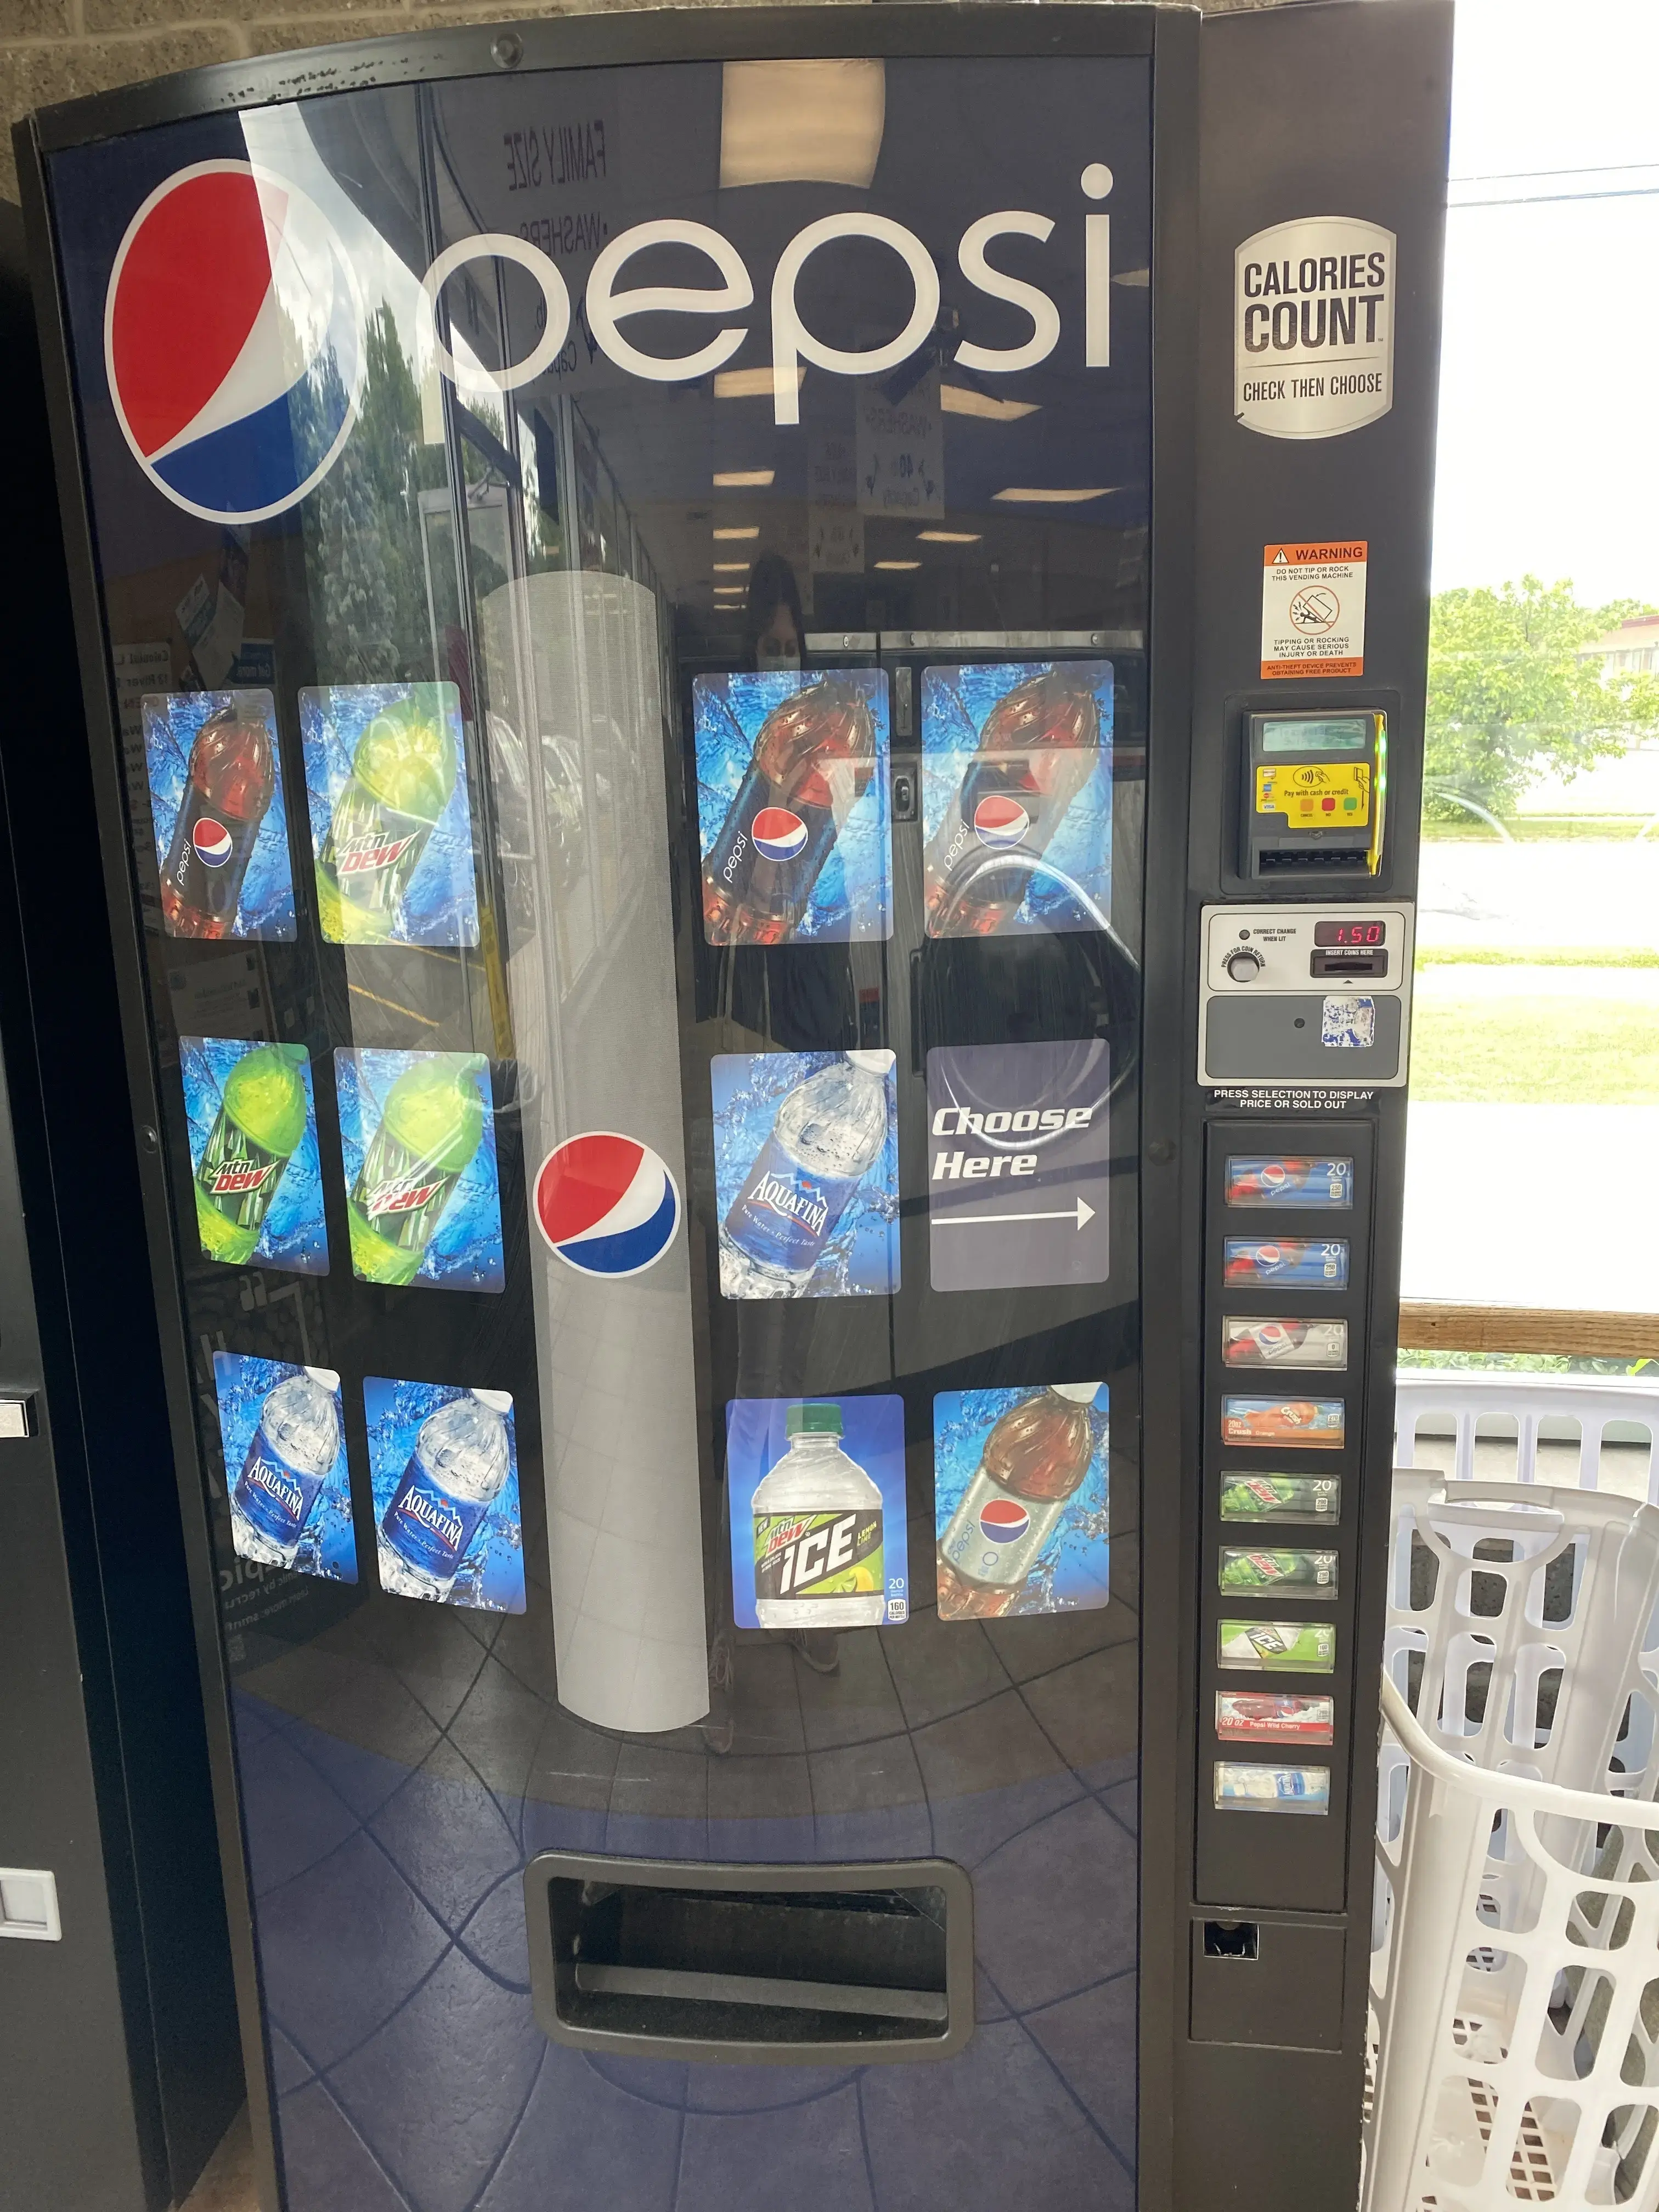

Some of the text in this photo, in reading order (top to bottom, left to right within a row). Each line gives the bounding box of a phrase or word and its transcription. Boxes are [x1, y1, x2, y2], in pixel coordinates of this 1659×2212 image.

[1244, 252, 1385, 298] CALORIES
[415, 163, 1113, 445] pepsi
[1244, 294, 1385, 353] COUNT
[1243, 373, 1383, 402] CHECK THEN CHOOSE
[1295, 547, 1363, 560] WARNING
[944, 819, 970, 871] pepsi
[176, 838, 191, 886] pepsi
[723, 832, 749, 883] pepsi
[1338, 926, 1380, 943] 1.50
[1221, 952, 1232, 968] PRESS
[1230, 946, 1241, 955] FOR
[1252, 949, 1266, 967] RETURN
[1214, 1090, 1374, 1099] PRESS SELECTION TO DISPLAY
[1240, 1099, 1347, 1109] PRICE OR SOLD OUT
[932, 1106, 1093, 1136] Choose
[932, 1150, 1037, 1180] Here
[1327, 1163, 1346, 1176] 20
[1271, 1182, 1291, 1197] pepsi
[747, 1170, 829, 1237] AQUAFINA
[742, 1204, 752, 1218] Pure
[753, 1215, 770, 1233] Water
[775, 1231, 800, 1244] Perfect
[1321, 1244, 1340, 1256] 20
[1266, 1262, 1286, 1276] pepsi
[1323, 1324, 1344, 1336] 20
[1280, 1407, 1302, 1424] Crush
[247, 1456, 303, 1521] AQUAFINA
[1313, 1480, 1332, 1491] 20
[244, 1481, 252, 1493] Pure
[252, 1492, 266, 1508] Water
[269, 1509, 286, 1523] Perfect
[398, 1485, 464, 1551] AQUAFINA
[394, 1511, 403, 1525] Pure
[403, 1522, 417, 1539] Water
[421, 1541, 441, 1555] Perfect
[856, 1532, 872, 1547] LIME
[857, 1521, 877, 1539] LEMON
[952, 1519, 975, 1564] pepsi
[780, 1513, 856, 1595] ICE
[1314, 1555, 1333, 1564] 20
[888, 1577, 905, 1589] 20
[890, 1601, 904, 1611] 160
[1249, 1632, 1284, 1650] ICE
[1222, 1716, 1234, 1726] 20
